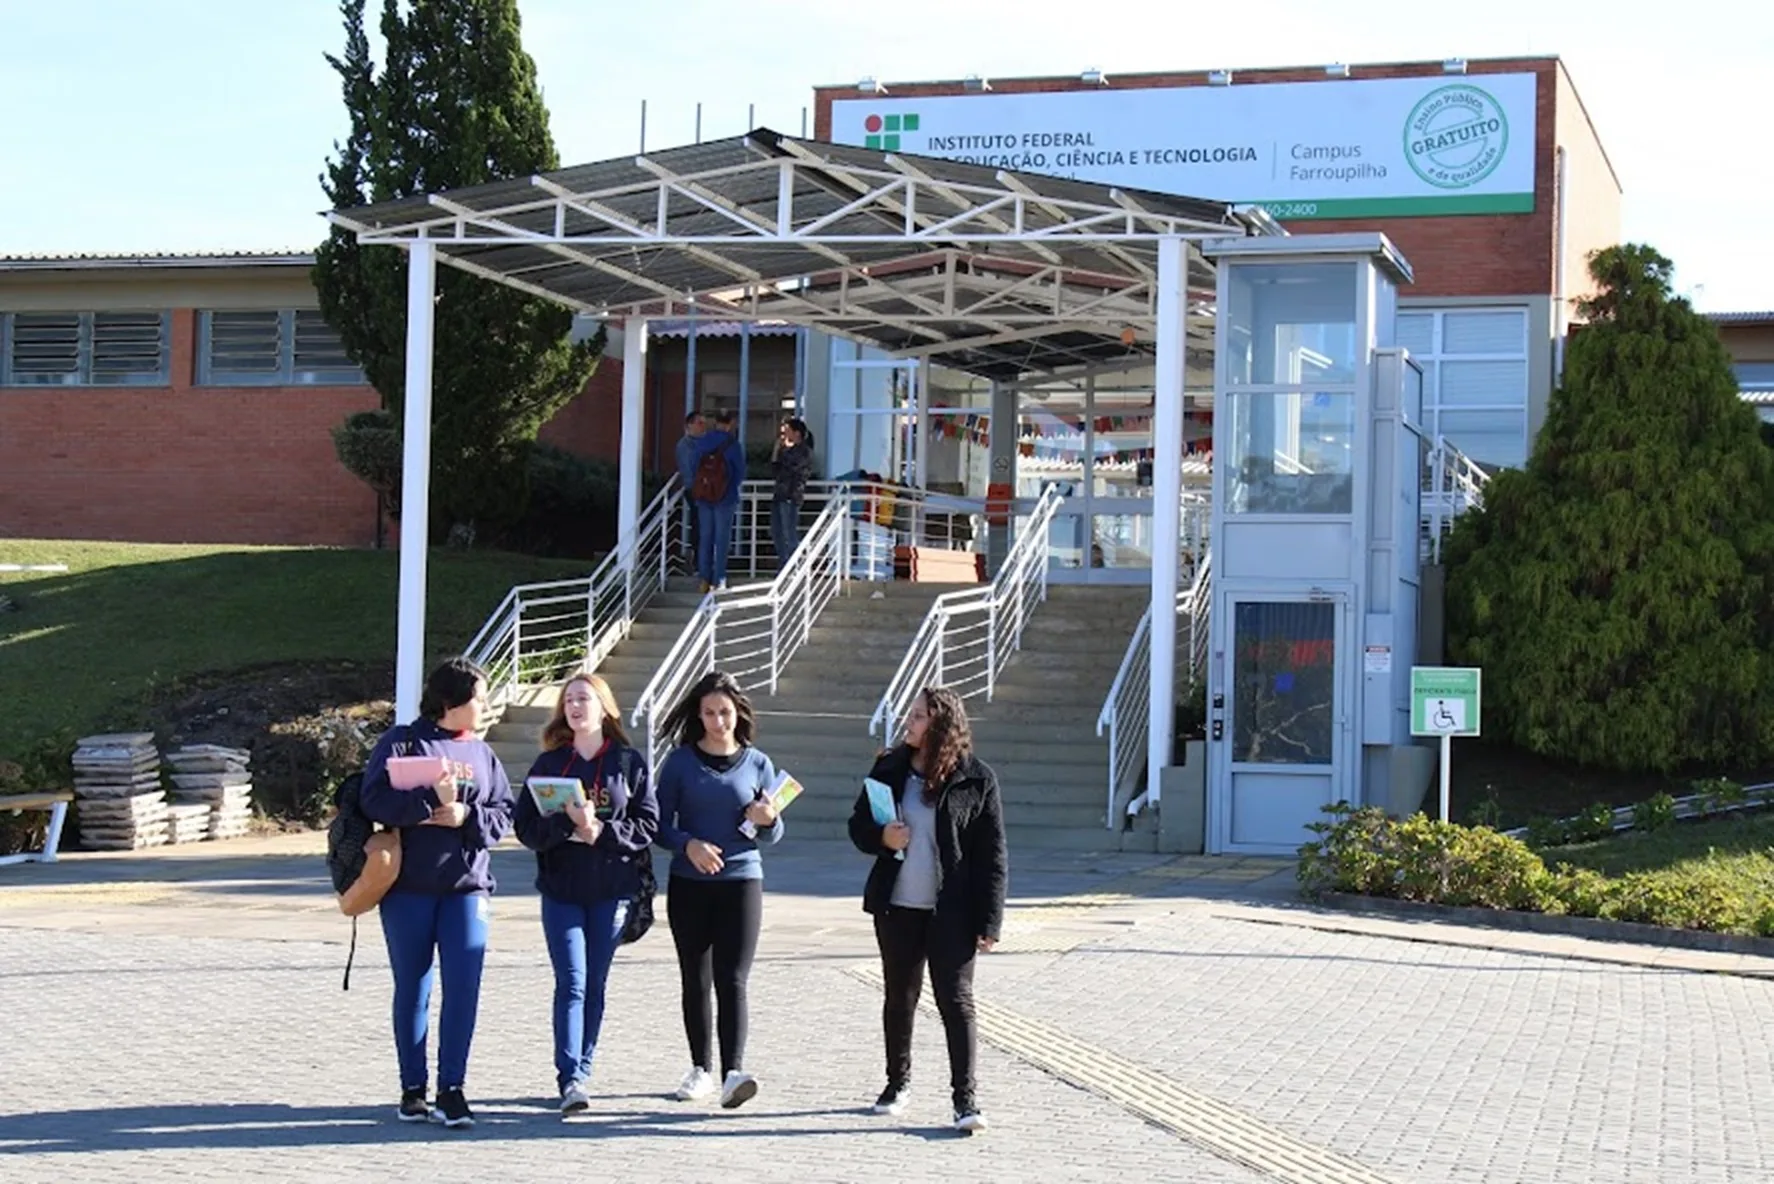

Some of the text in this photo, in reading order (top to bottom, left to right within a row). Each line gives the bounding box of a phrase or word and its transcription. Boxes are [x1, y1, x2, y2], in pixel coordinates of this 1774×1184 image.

[1413, 92, 1484, 131] Ensino Público
[928, 132, 1094, 150] INSTITUTO FEDERAL
[1411, 118, 1500, 155] GRATUITO
[1055, 149, 1125, 167] CIÊNCIA
[1129, 151, 1138, 165] E
[1145, 147, 1257, 164] TECNOLOGIA
[1290, 143, 1362, 162] Campus
[1290, 163, 1388, 182] Farroupilha
[1435, 170, 1449, 180] de
[1451, 147, 1496, 183] qualidade
[1265, 203, 1317, 216] 60-2400
[587, 787, 611, 806] RS
